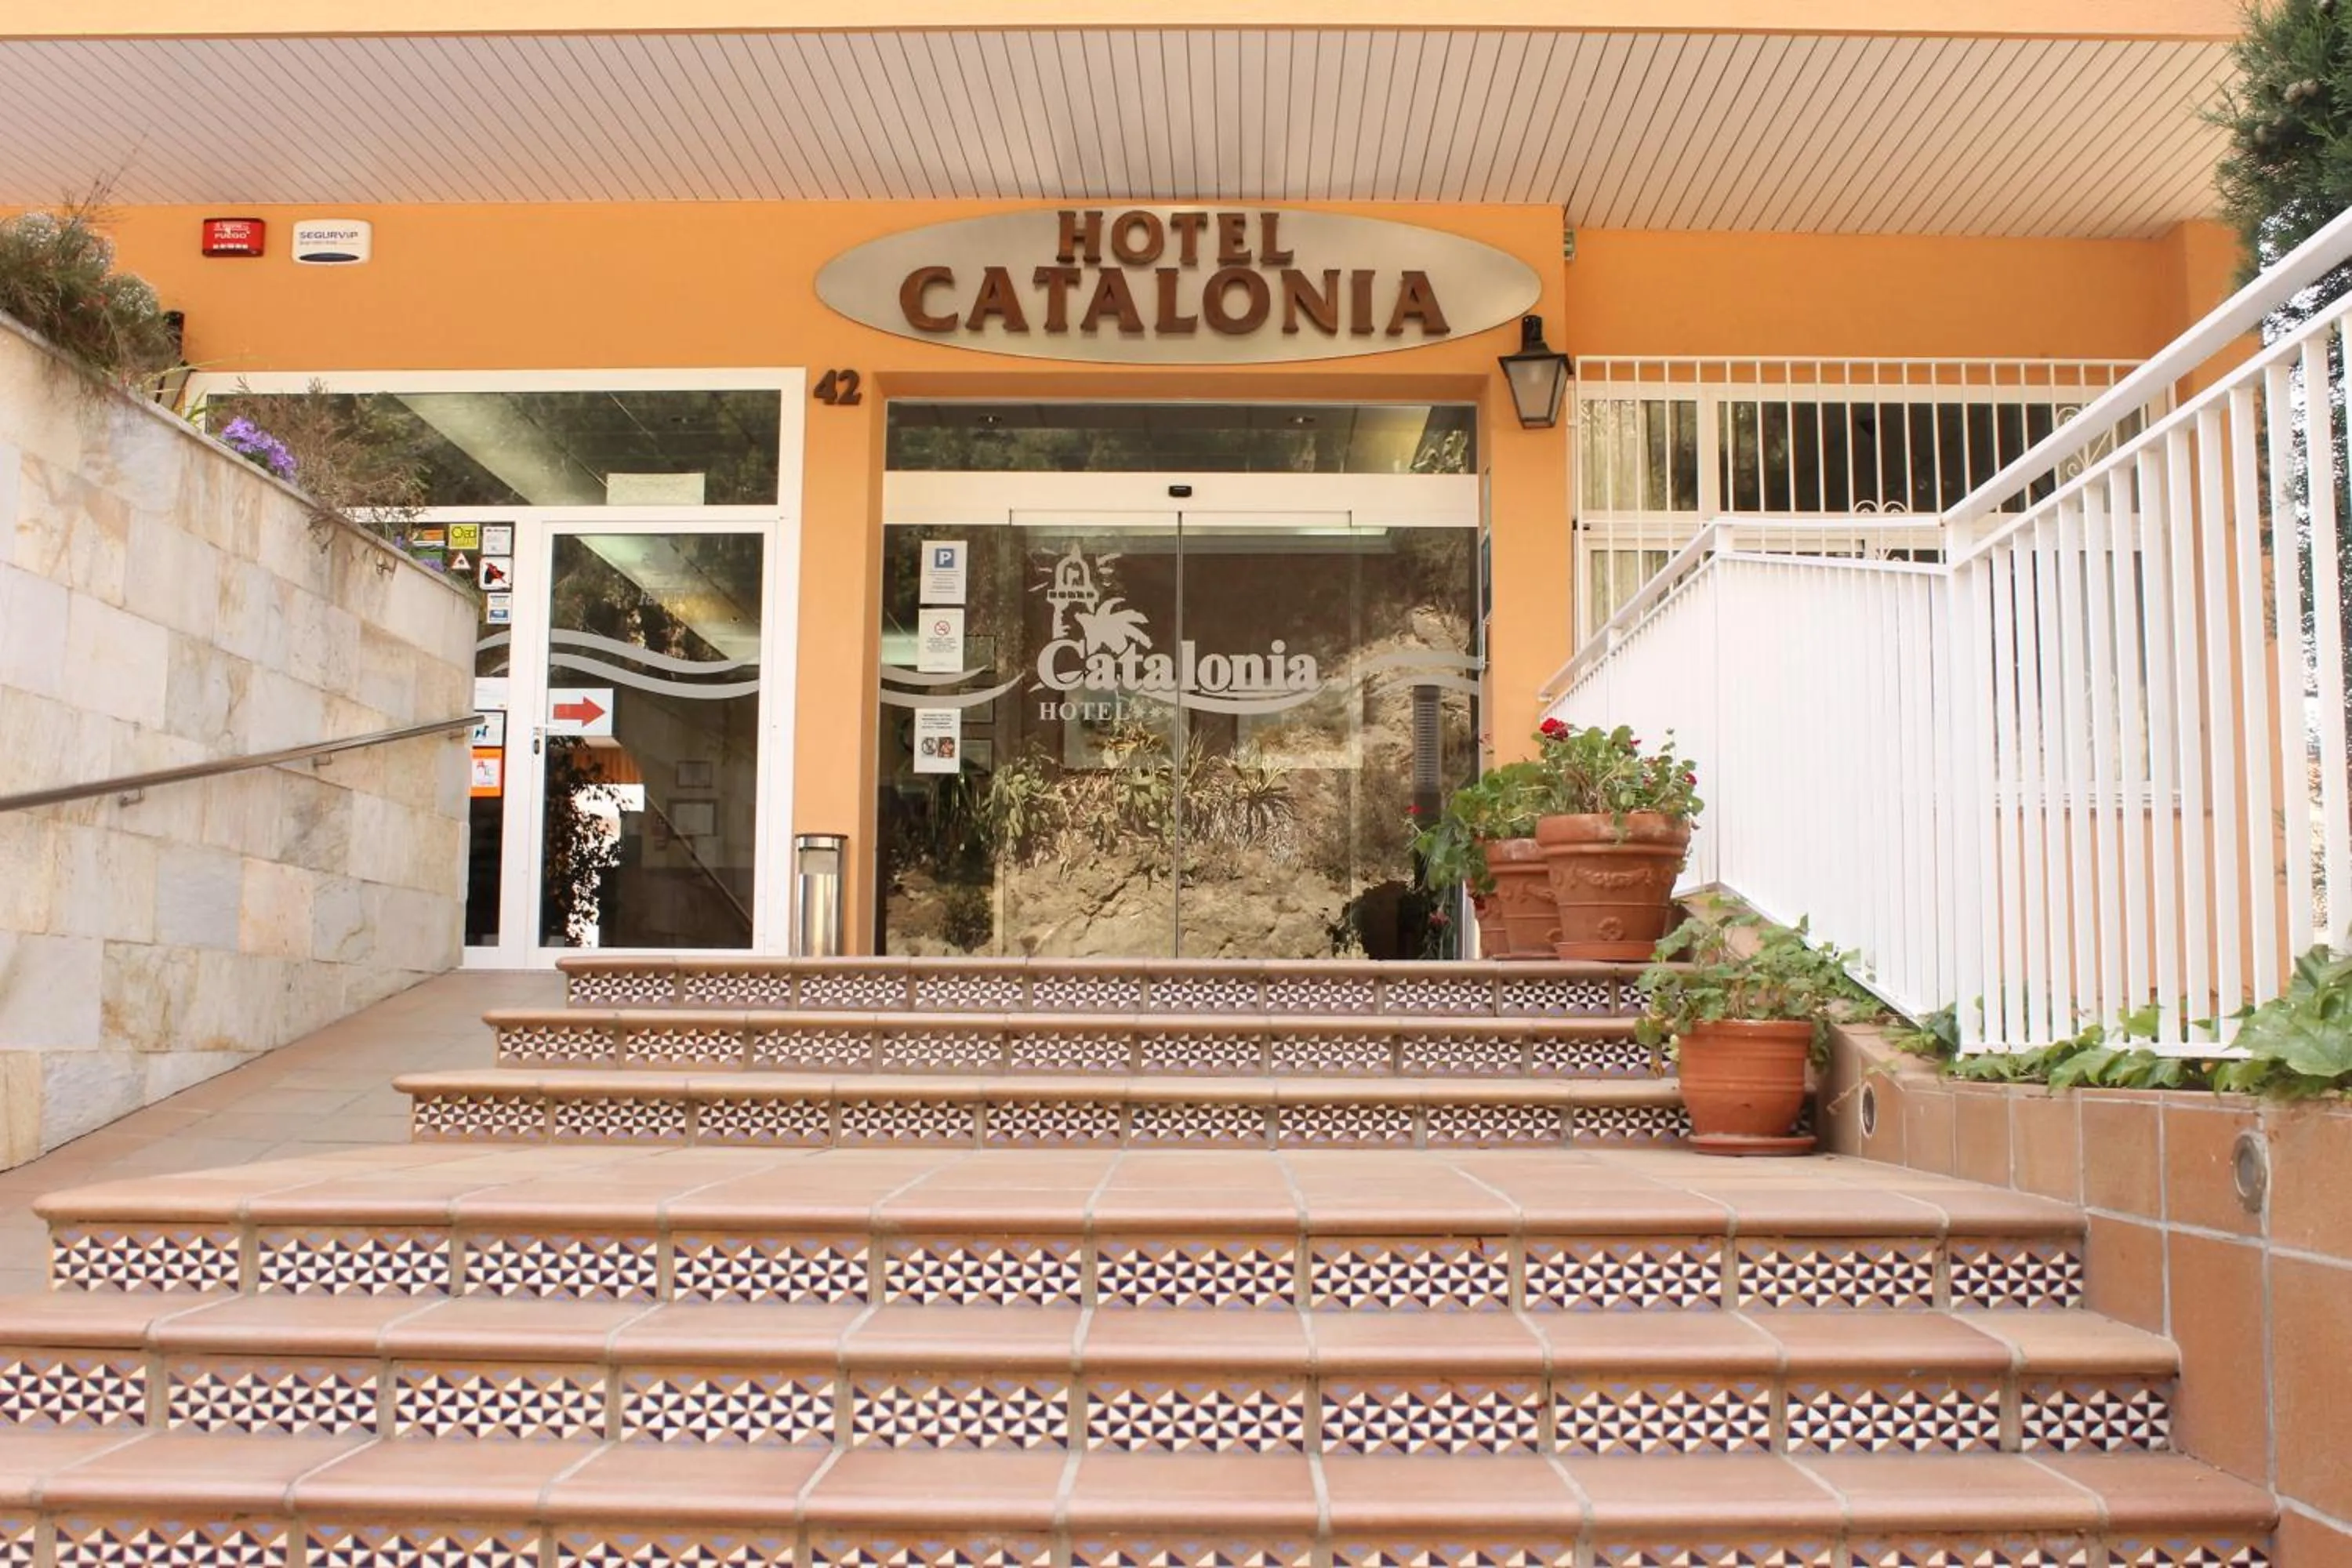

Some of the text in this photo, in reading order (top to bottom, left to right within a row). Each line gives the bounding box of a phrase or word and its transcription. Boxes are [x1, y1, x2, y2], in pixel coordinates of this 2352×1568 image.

[1056, 209, 1294, 266] HOTEL
[899, 266, 1450, 336] CATALONIA
[814, 369, 862, 405] 42
[938, 551, 952, 565] P
[1037, 639, 1319, 691] Catalonia
[1040, 702, 1131, 721] HOTEL
